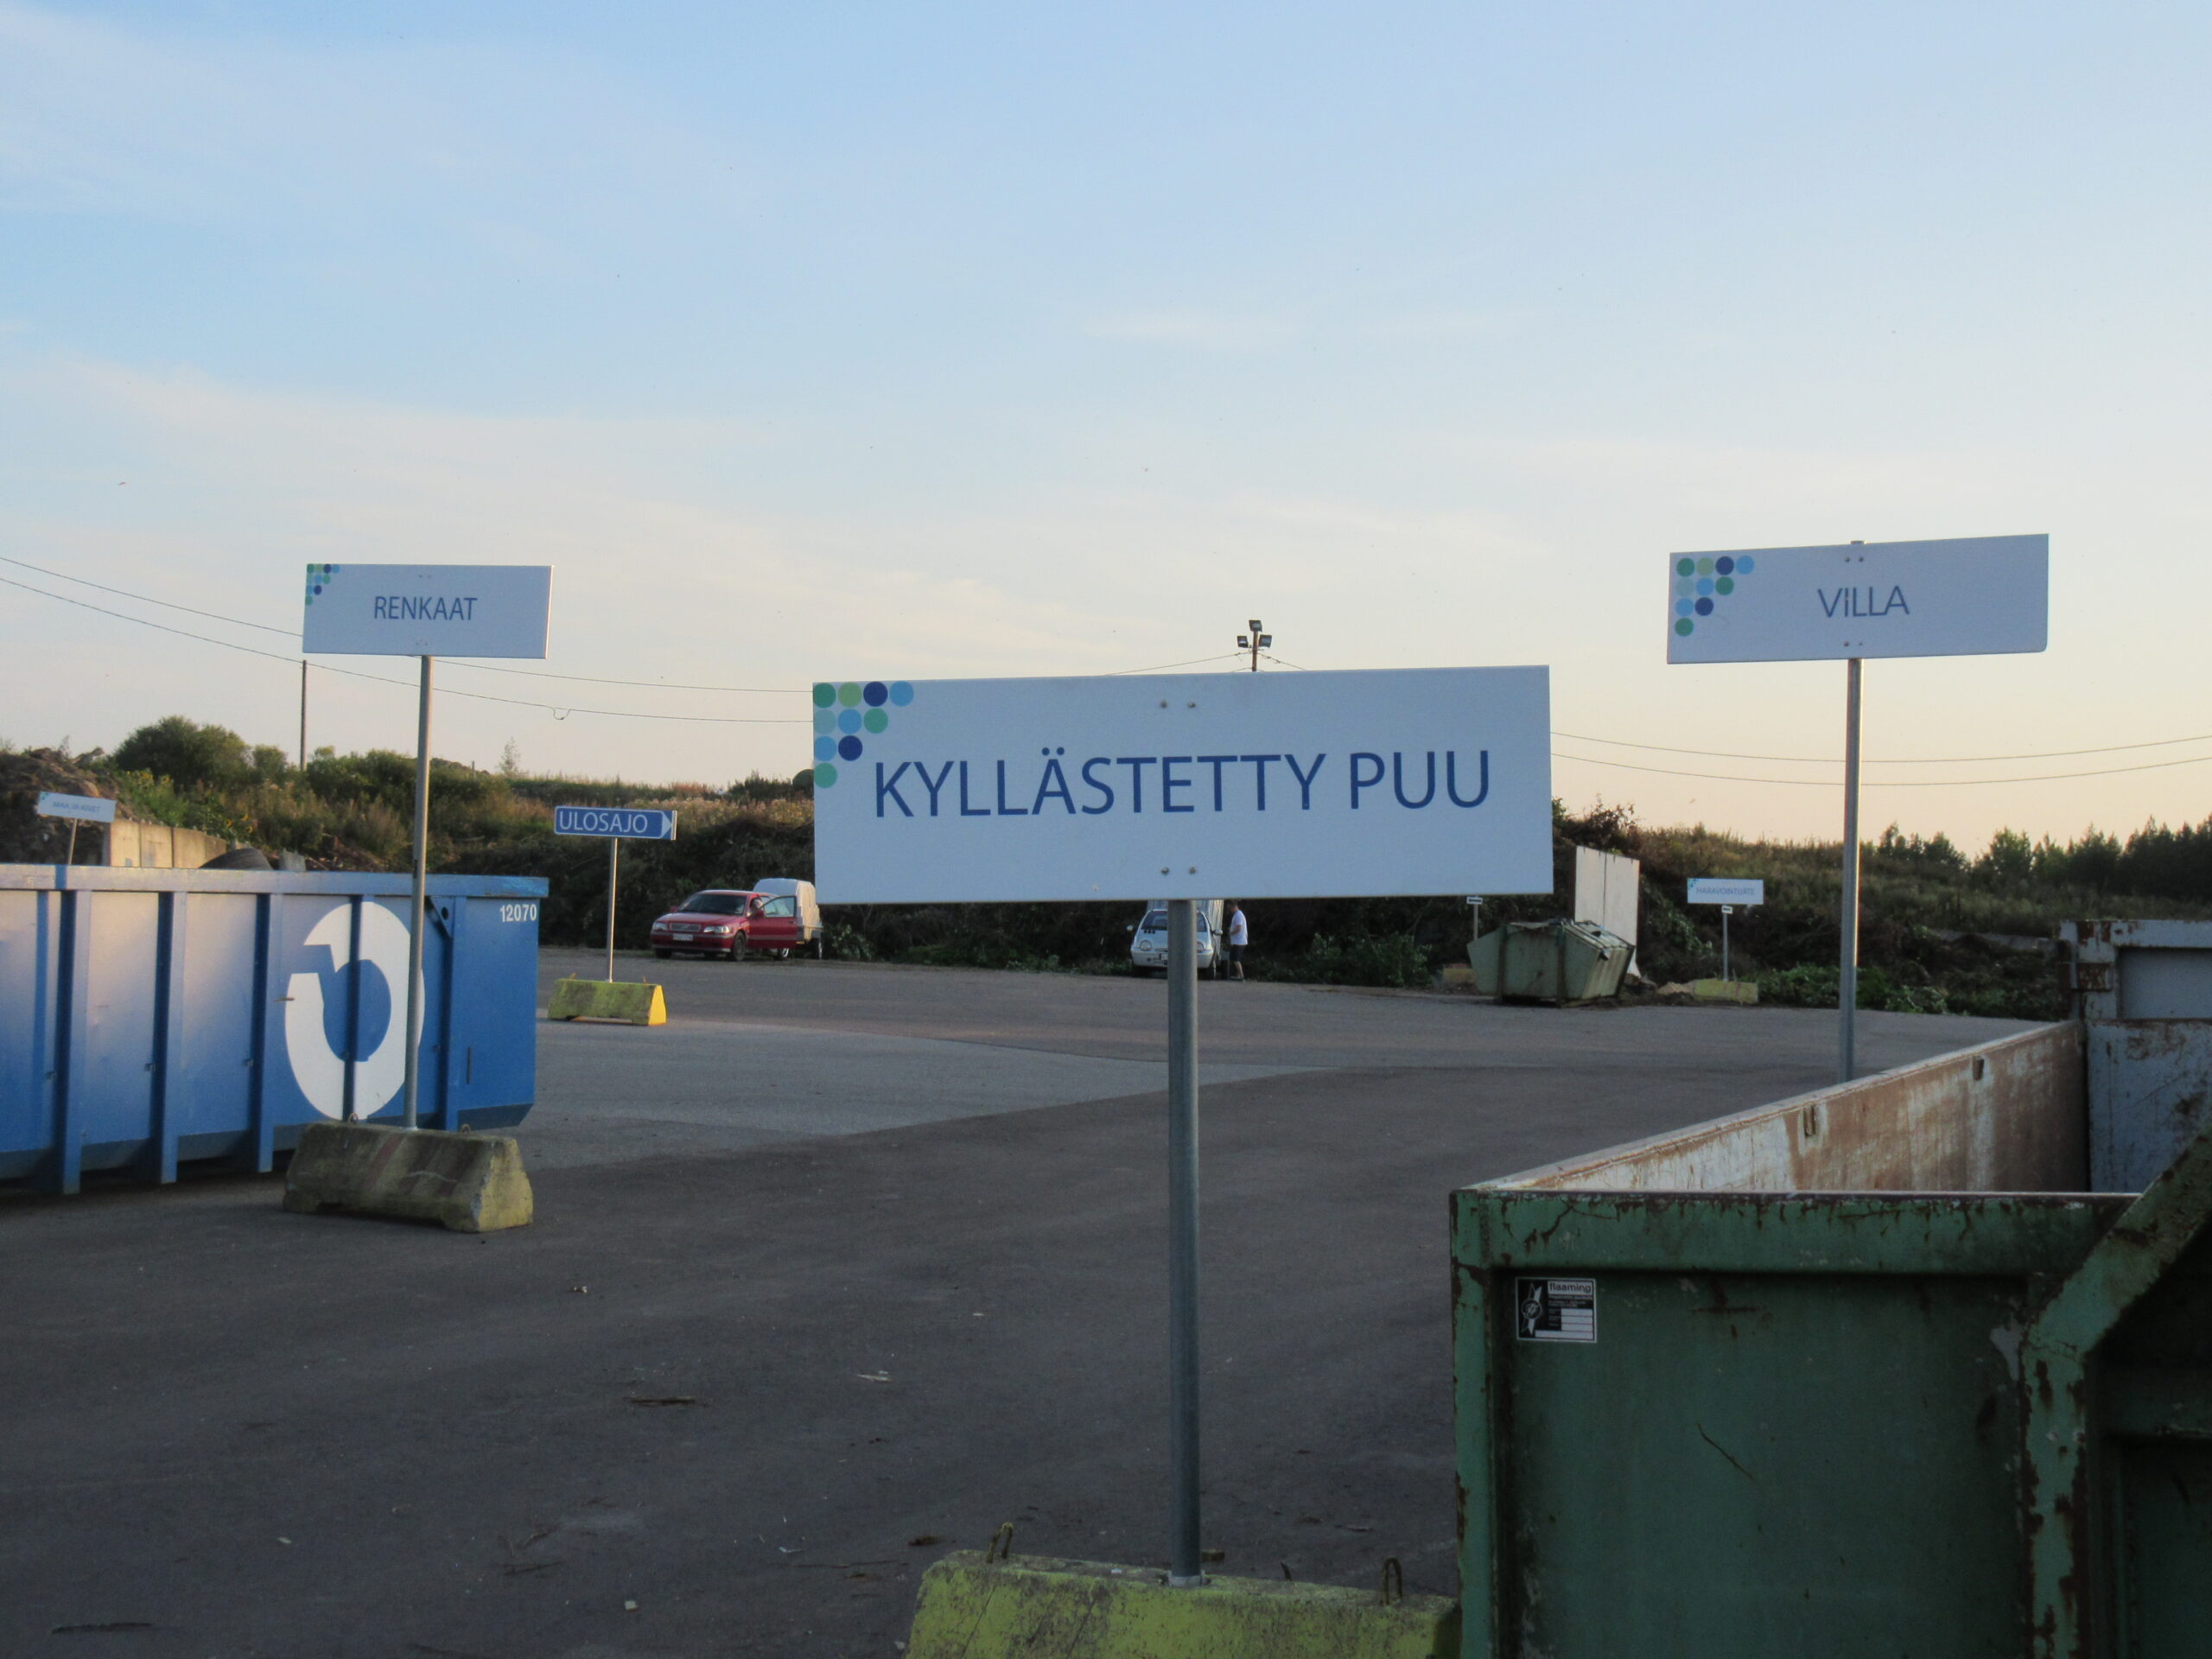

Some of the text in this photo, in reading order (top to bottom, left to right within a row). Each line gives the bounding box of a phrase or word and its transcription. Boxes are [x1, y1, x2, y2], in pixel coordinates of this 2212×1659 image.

[373, 595, 478, 620] RENKAAT
[1817, 585, 1910, 618] VILLA
[874, 747, 1490, 818] KYLLÄSTETTY PUU
[559, 810, 648, 834] ULOSAJO
[499, 904, 537, 923] 12070
[1548, 1282, 1592, 1294] flaaming
